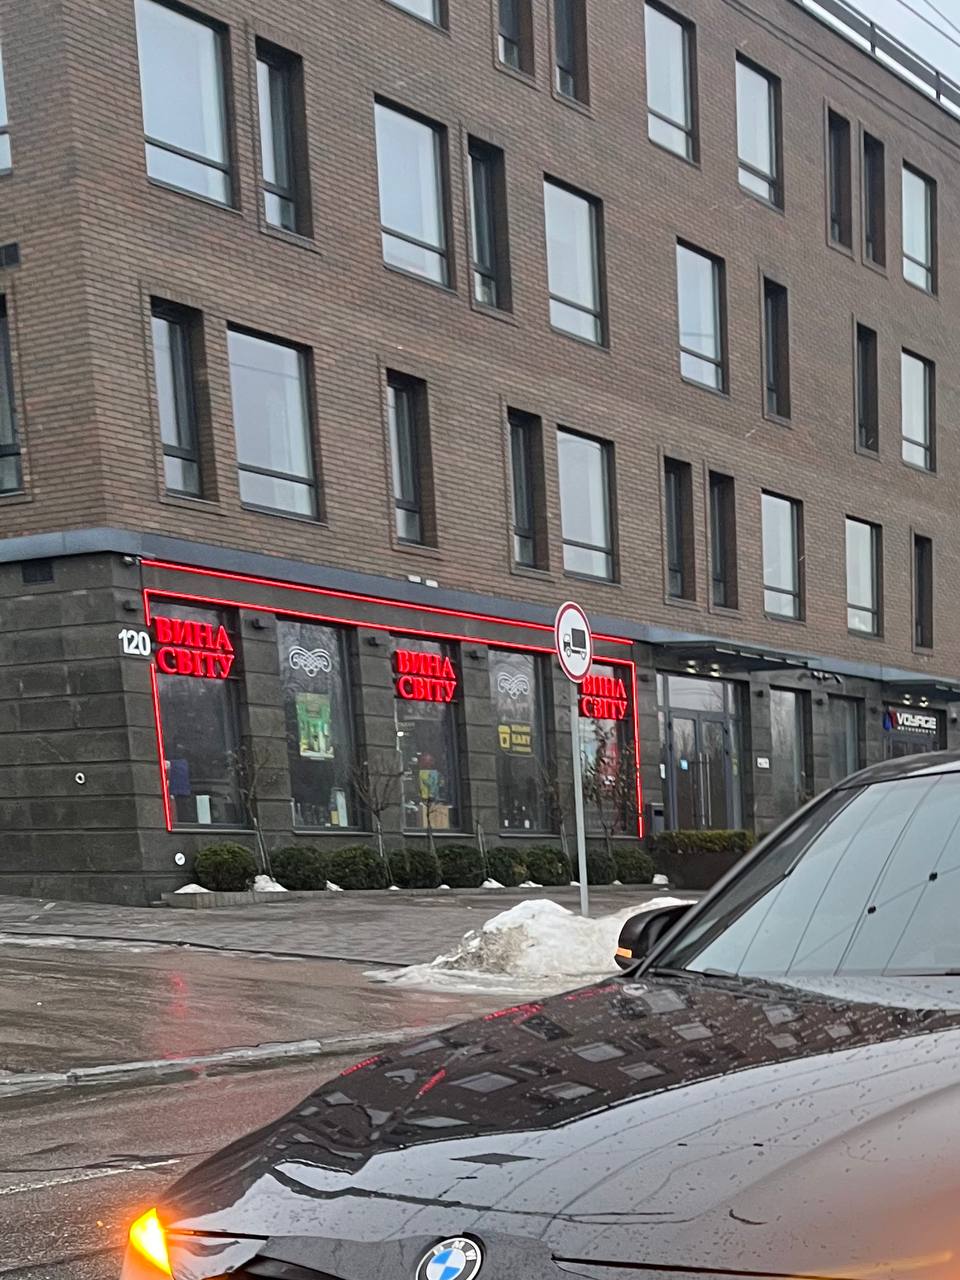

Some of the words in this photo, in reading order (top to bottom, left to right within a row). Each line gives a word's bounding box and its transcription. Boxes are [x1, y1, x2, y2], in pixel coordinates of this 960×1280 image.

[118, 629, 151, 656] 120
[154, 615, 234, 652] ВИНА
[156, 646, 235, 678] СВІТУ
[396, 649, 456, 679] ВИНА
[397, 675, 457, 702] СВІТУ
[582, 674, 627, 698] ВИНА
[582, 696, 628, 720] СВІТУ
[896, 712, 937, 729] VOYAGE
